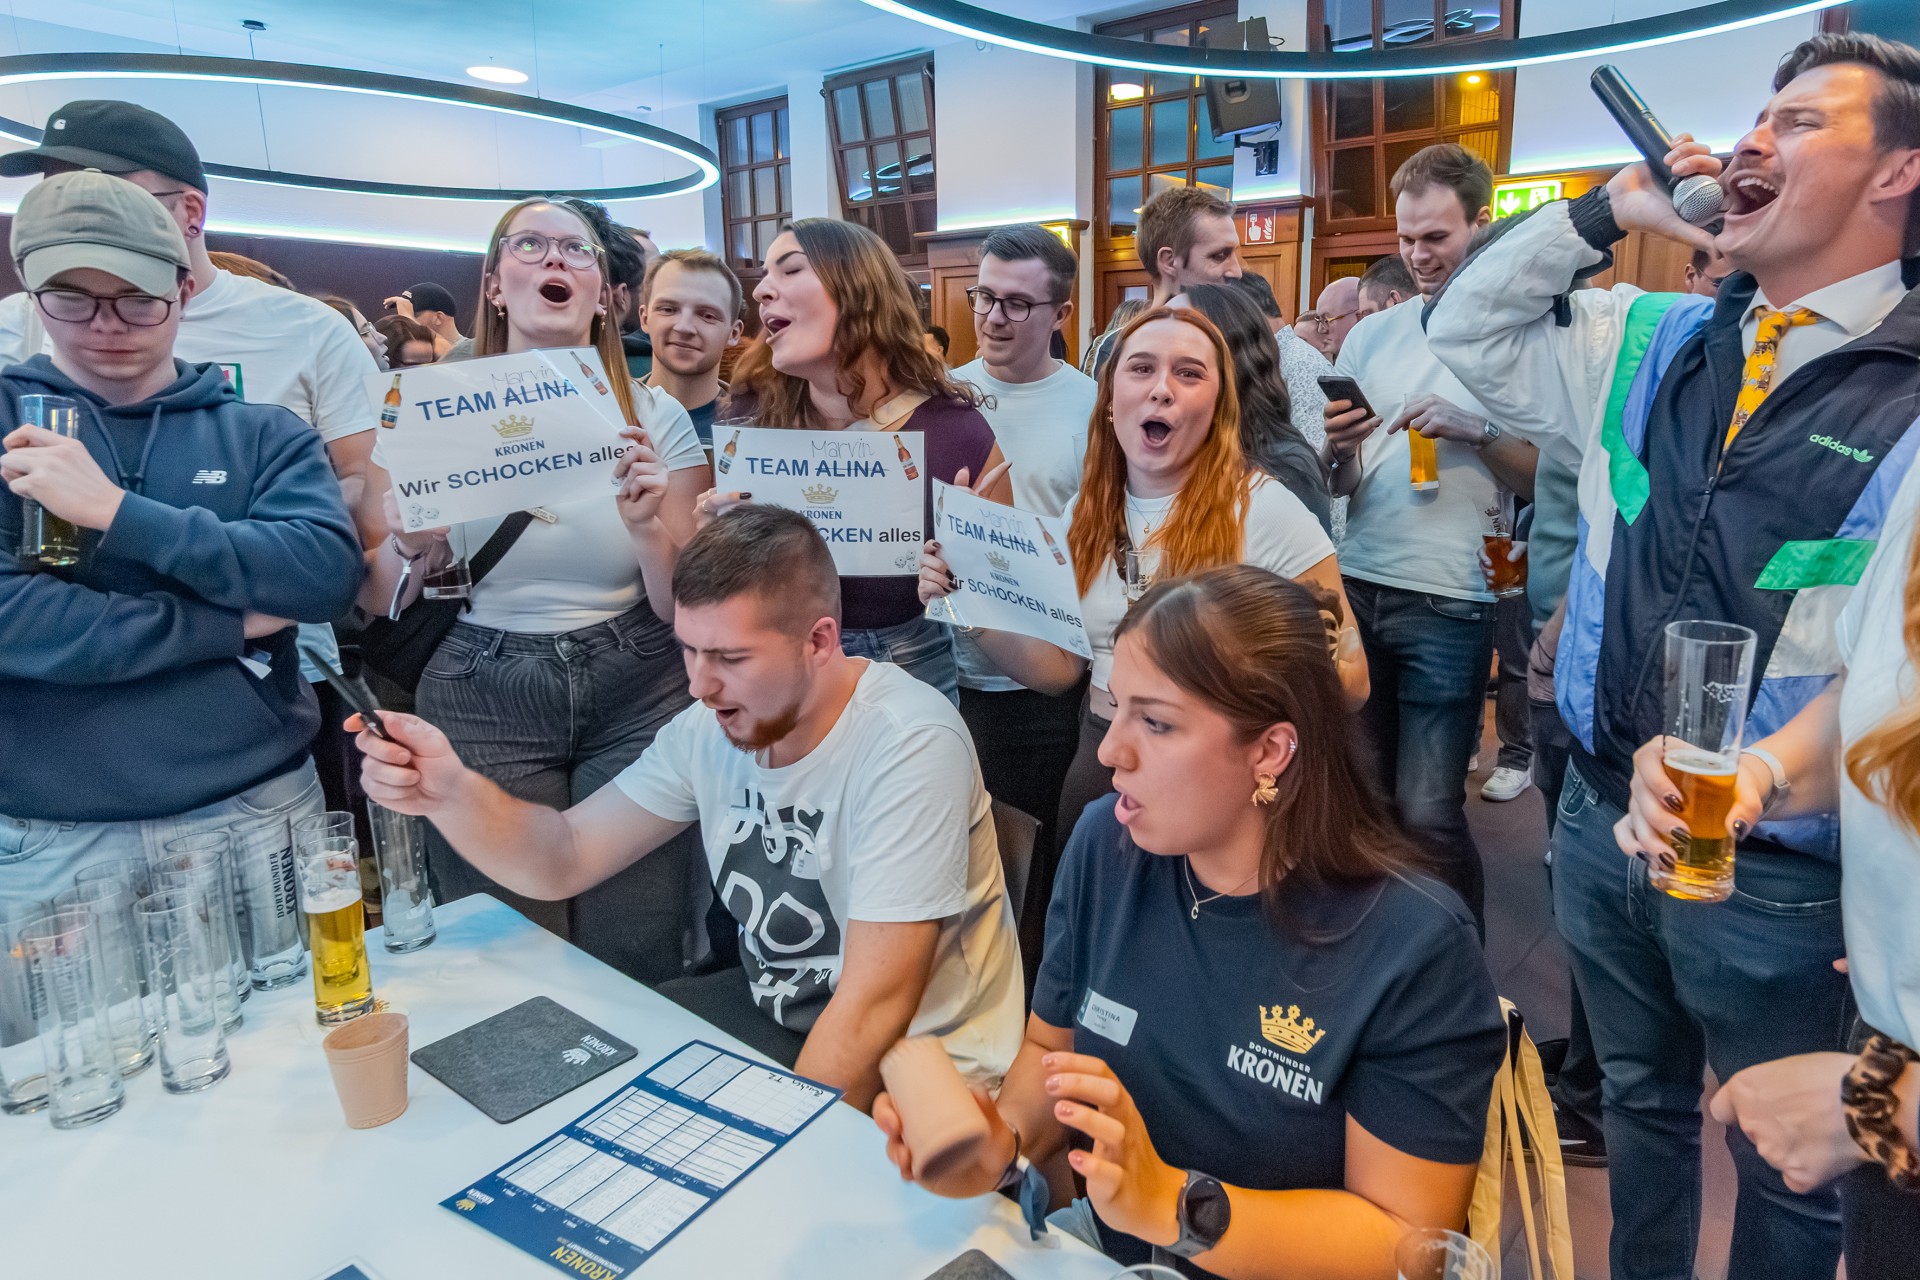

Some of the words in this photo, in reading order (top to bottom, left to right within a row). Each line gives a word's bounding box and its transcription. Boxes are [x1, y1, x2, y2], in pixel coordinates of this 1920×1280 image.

[491, 366, 556, 390] Marvin
[415, 391, 496, 421] TEAM
[504, 378, 579, 407] ALINA
[495, 440, 545, 457] KRONEN
[811, 438, 875, 458] Marvin
[1809, 434, 1852, 456] adidas
[399, 479, 441, 498] Wir
[447, 451, 582, 489] SCHOCKEN
[745, 457, 809, 477] TEAM
[816, 460, 886, 478] ALINA
[817, 527, 873, 543] CKEN
[878, 528, 921, 543] alles
[947, 514, 986, 542] TEAM
[989, 529, 1039, 557] ALINA
[990, 571, 1020, 587] KRONEN
[967, 577, 1047, 616] SCHOCKEN
[1050, 607, 1083, 628] alles
[269, 852, 285, 918] DORTMUNDER
[280, 846, 296, 915] KRONEN
[580, 1034, 618, 1056] KRONEN
[1248, 1041, 1311, 1074] DORTMUNDER
[1226, 1045, 1324, 1105] KRONEN
